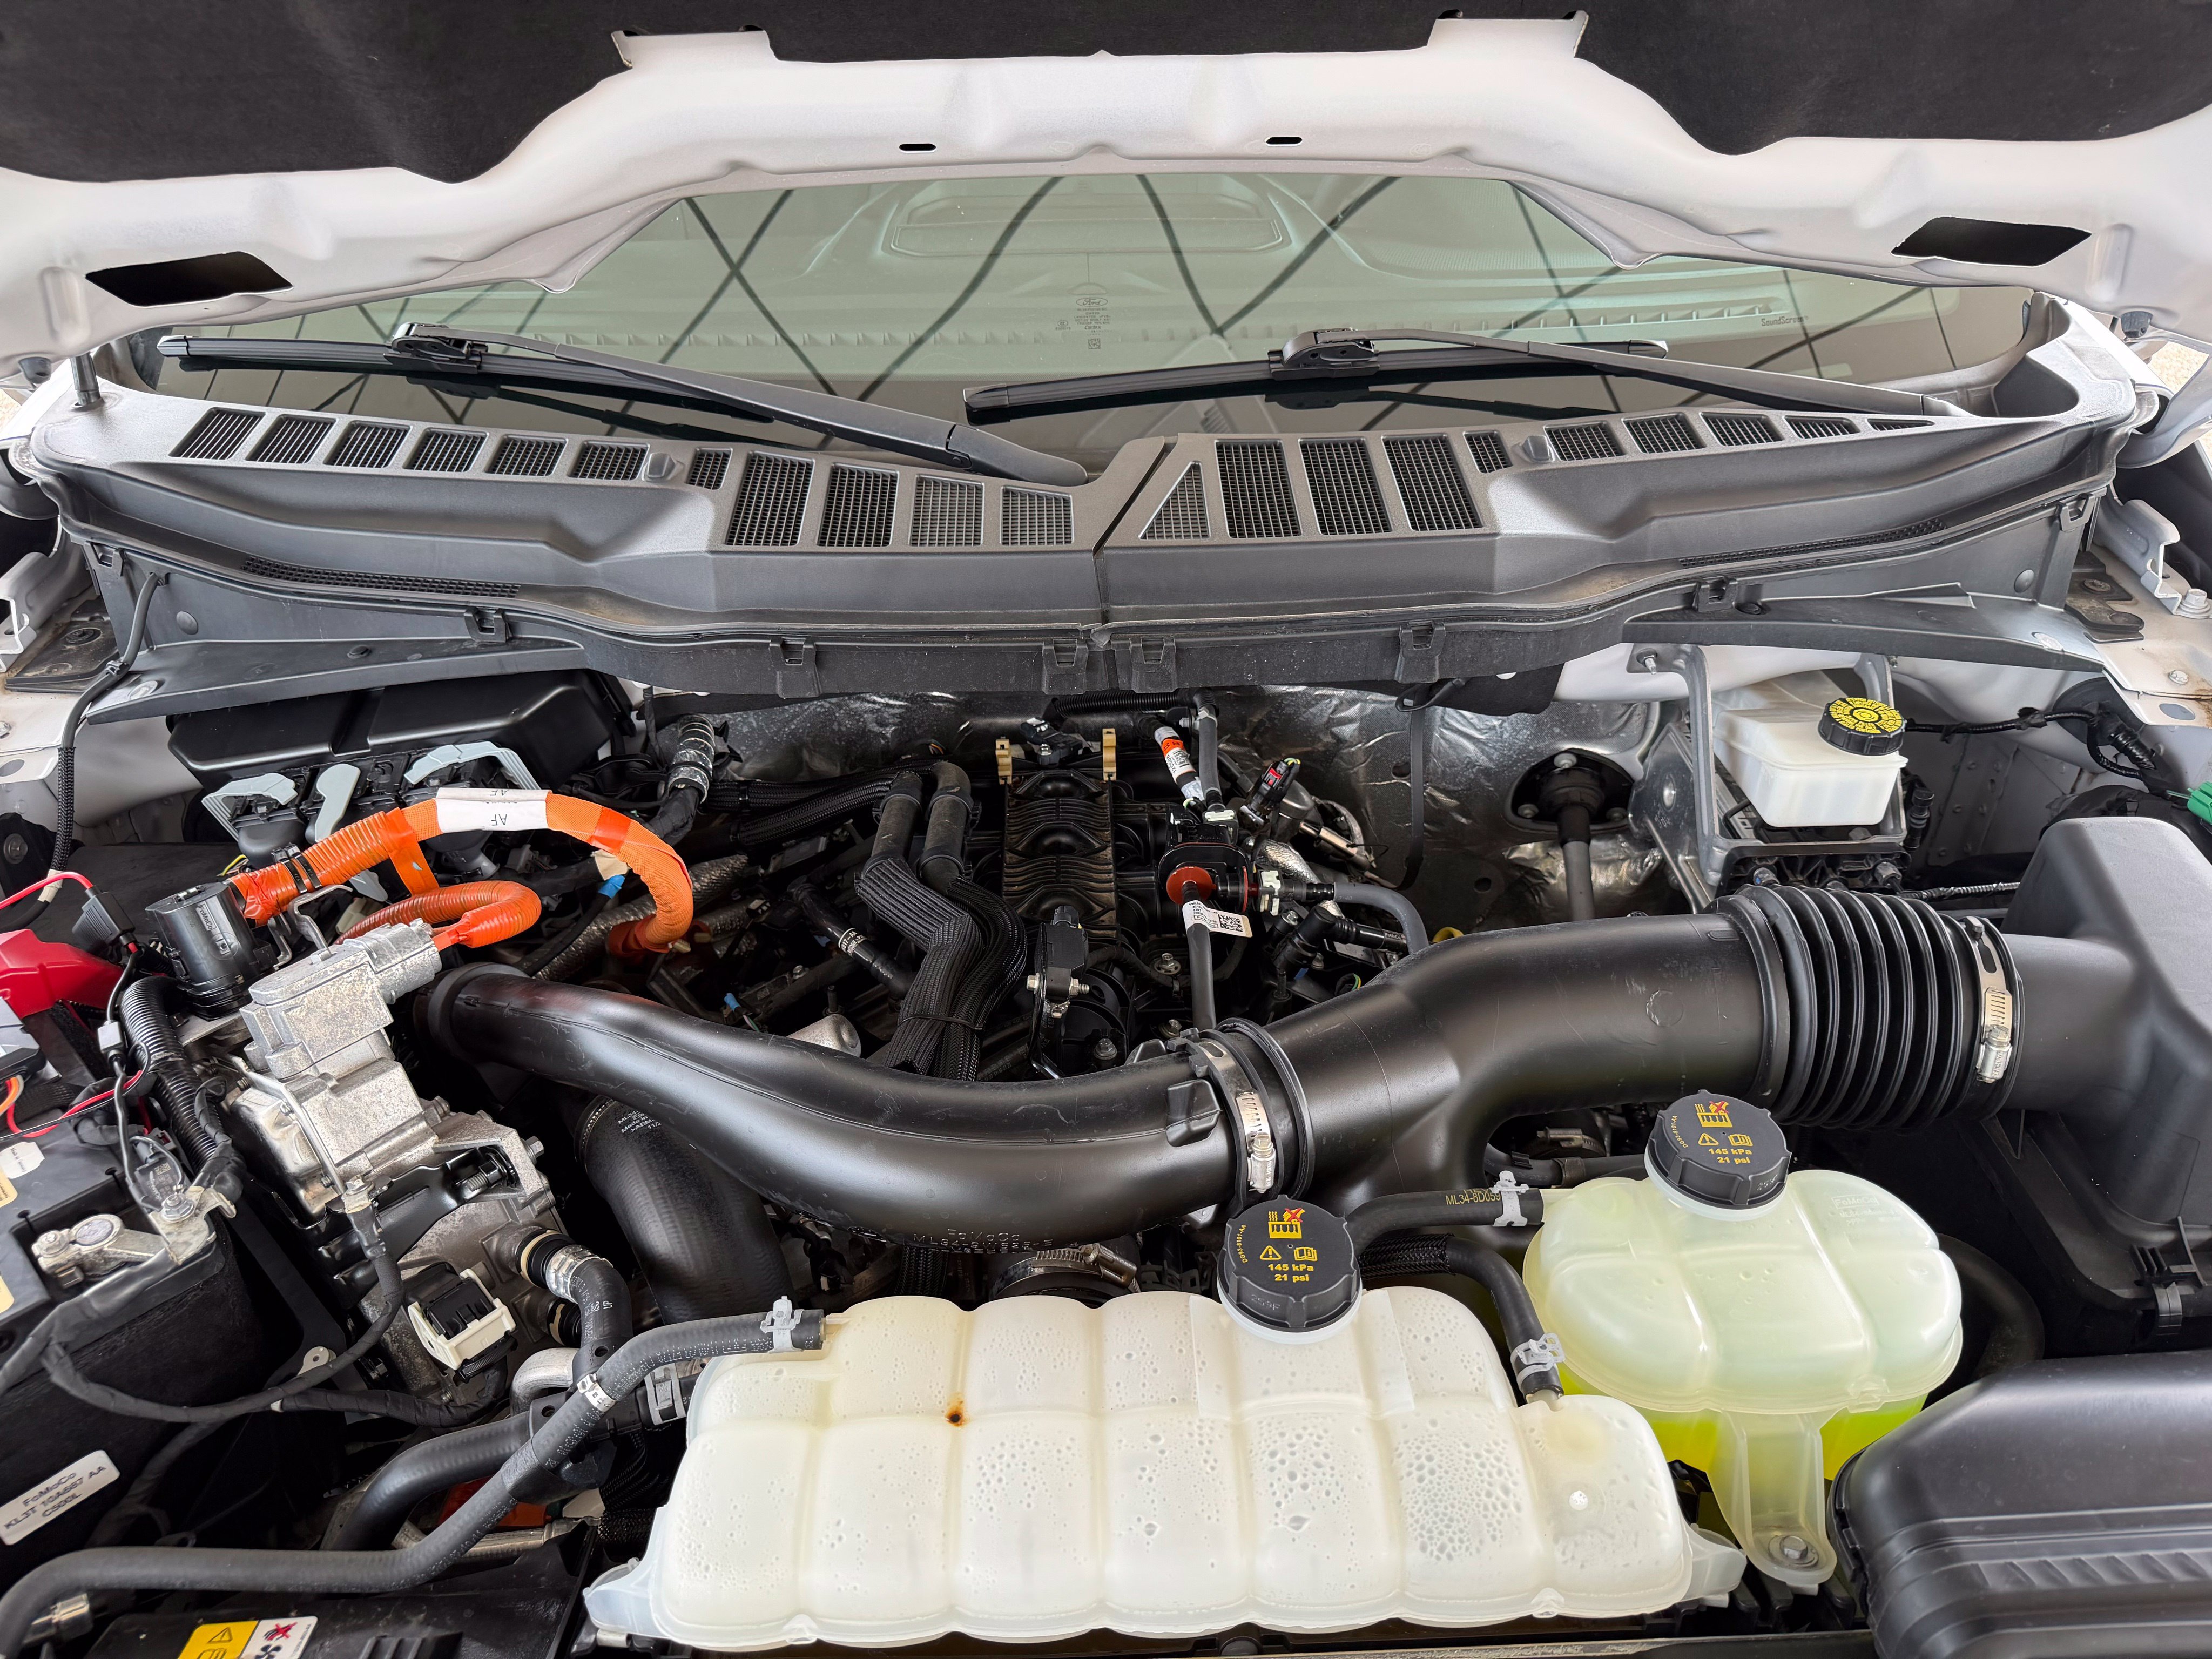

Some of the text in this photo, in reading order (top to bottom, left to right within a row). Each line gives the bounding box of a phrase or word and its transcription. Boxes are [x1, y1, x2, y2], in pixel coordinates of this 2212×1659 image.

[491, 814, 507, 826] AF
[198, 905, 213, 930] FoMoCo
[621, 1120, 640, 1133] Made
[948, 1229, 1020, 1242] FoMoCo
[1236, 1225, 1248, 1263] DG93-8101-AA
[1292, 1264, 1314, 1272] kPa
[1293, 1274, 1310, 1283] psi
[603, 1300, 613, 1309] UP
[89, 1466, 106, 1479] AA
[23, 1472, 77, 1507] FoMoCo
